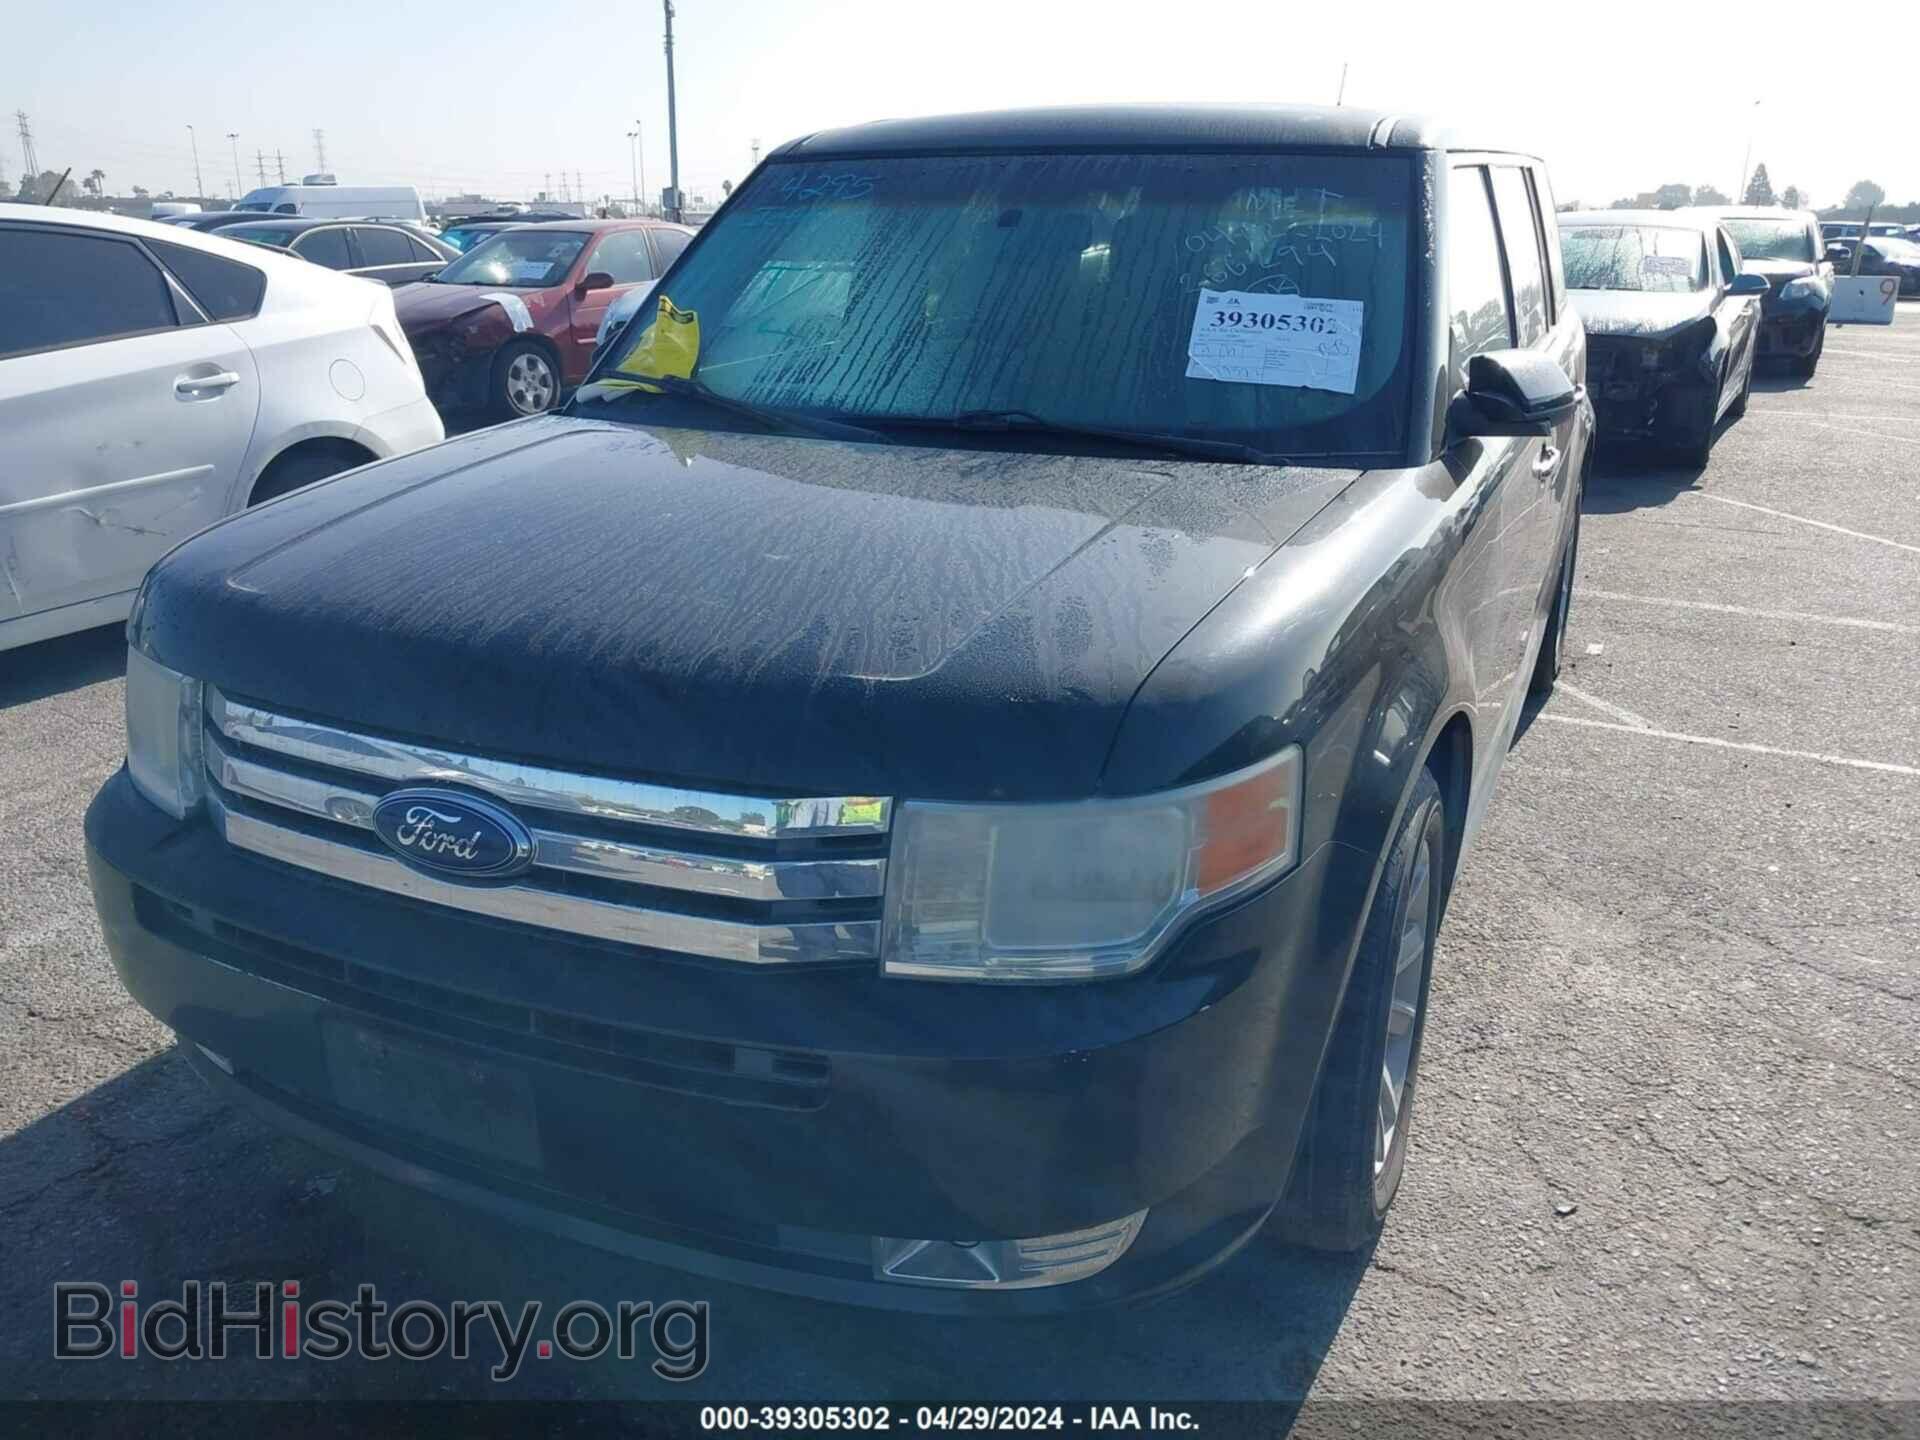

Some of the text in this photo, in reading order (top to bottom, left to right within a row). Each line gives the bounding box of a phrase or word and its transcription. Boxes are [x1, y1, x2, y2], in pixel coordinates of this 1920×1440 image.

[1879, 279, 1898, 305] 9
[1208, 310, 1337, 336] 39305302
[396, 806, 482, 860] Ford
